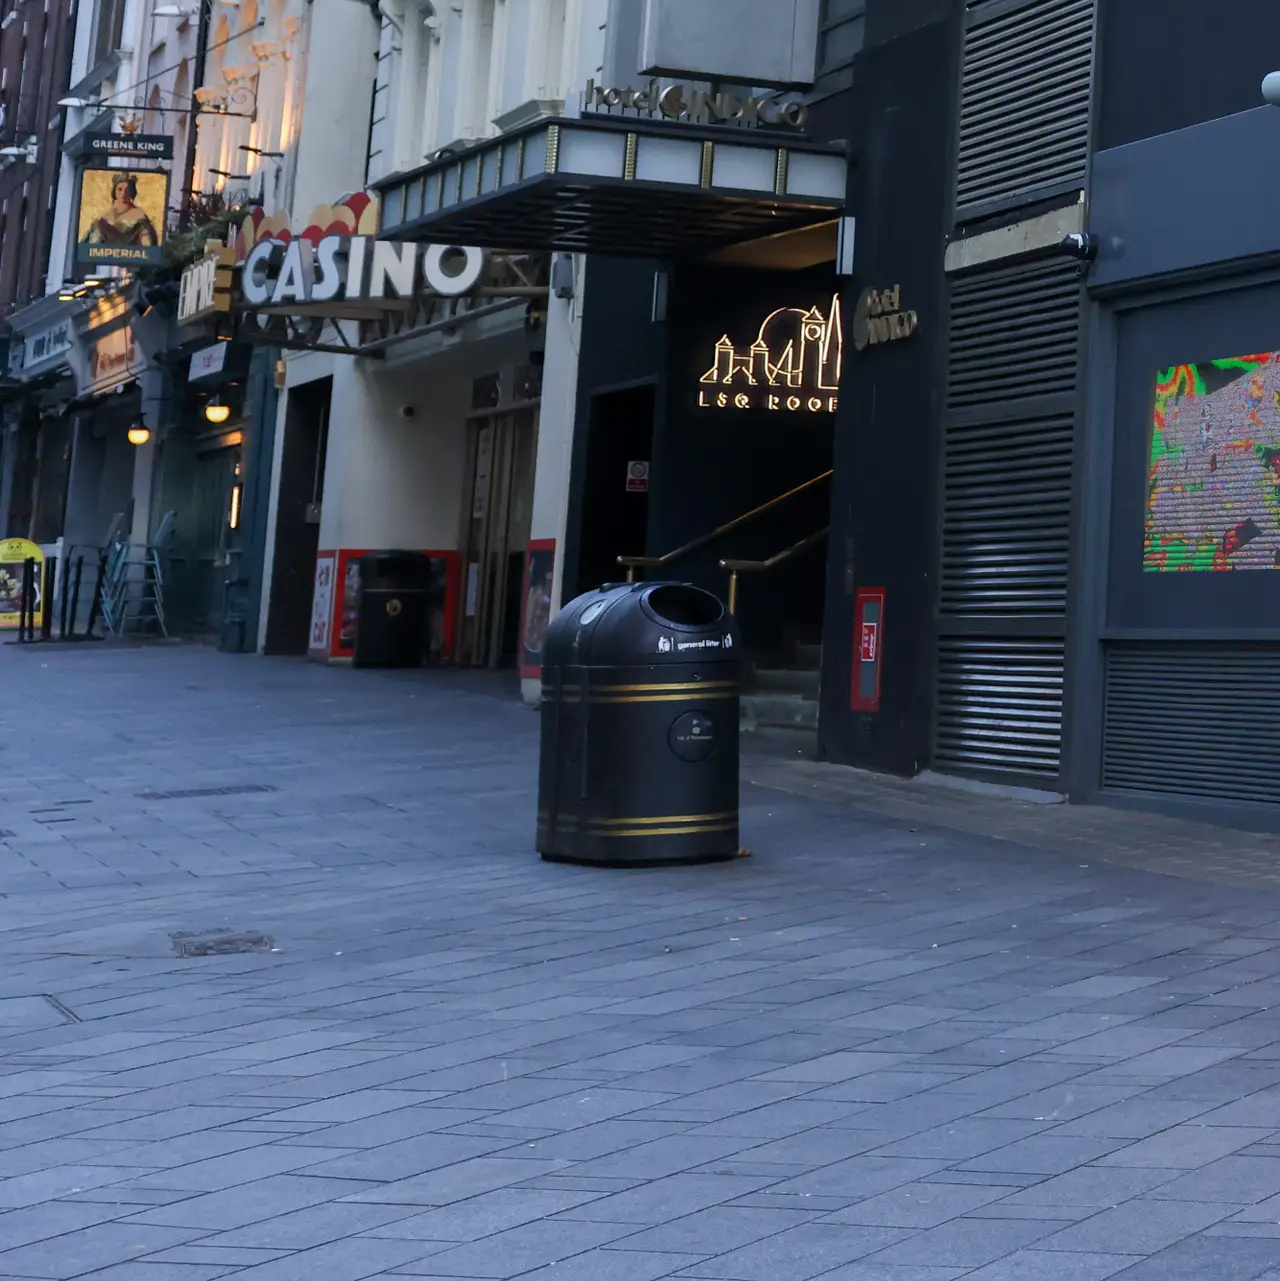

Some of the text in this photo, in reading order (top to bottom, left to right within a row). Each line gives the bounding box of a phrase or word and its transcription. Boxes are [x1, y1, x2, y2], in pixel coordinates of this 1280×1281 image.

[585, 77, 660, 111] hotel
[92, 139, 134, 150] GREENE
[137, 140, 165, 152] KING
[88, 247, 149, 260] IMPERIAL
[242, 234, 484, 305] CASINO
[698, 390, 750, 409] LSQ
[677, 638, 720, 650] general litter
